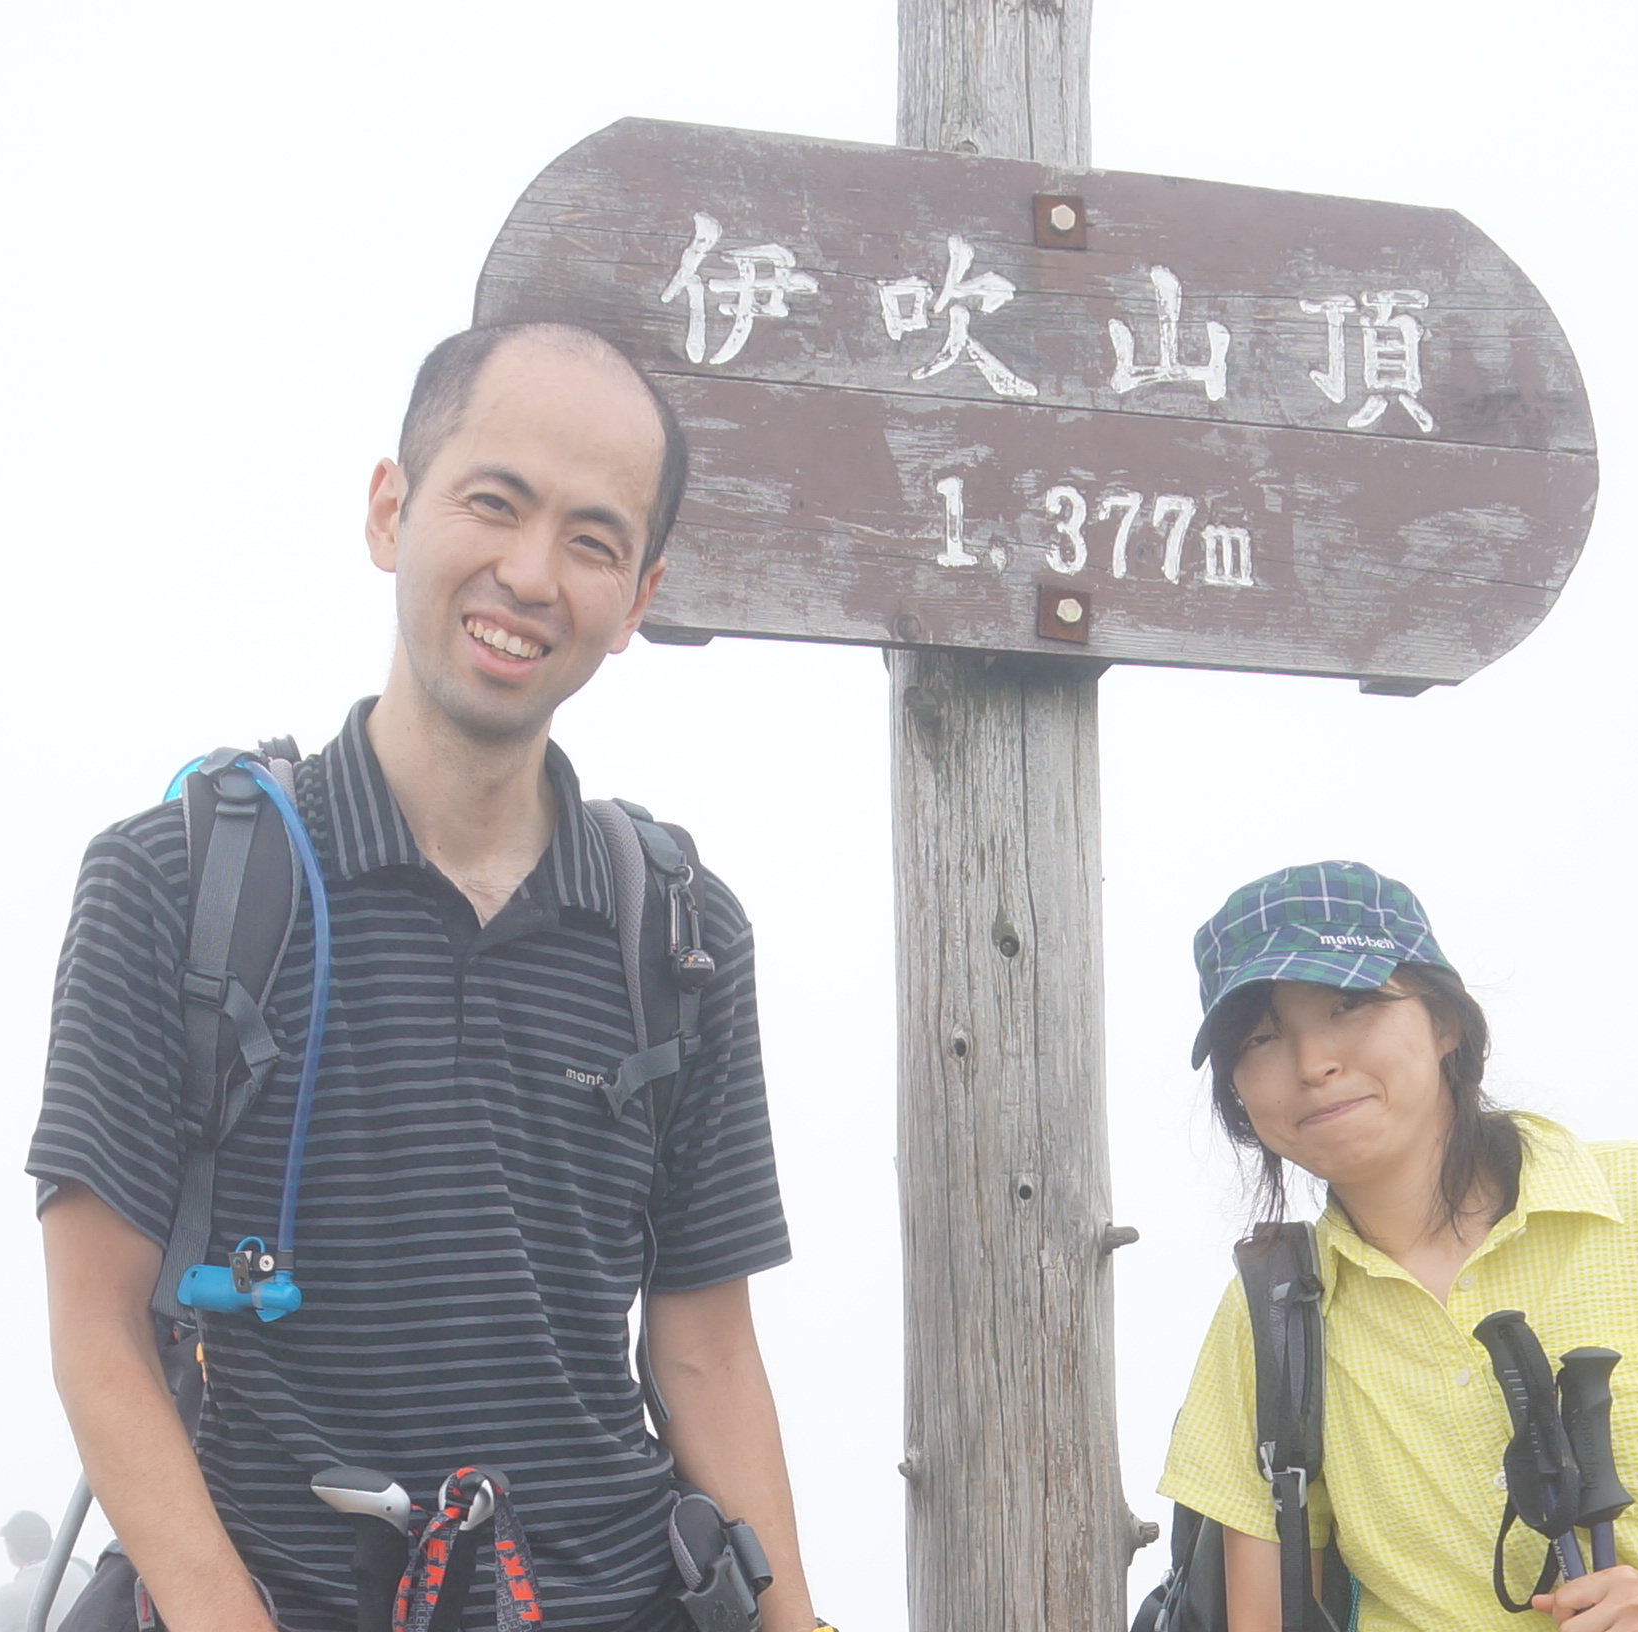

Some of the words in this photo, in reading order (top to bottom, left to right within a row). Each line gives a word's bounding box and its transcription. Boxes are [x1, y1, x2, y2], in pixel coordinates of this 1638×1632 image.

[660, 211, 1437, 433] 伊吹山頂
[495, 1540, 543, 1621] LEKI
